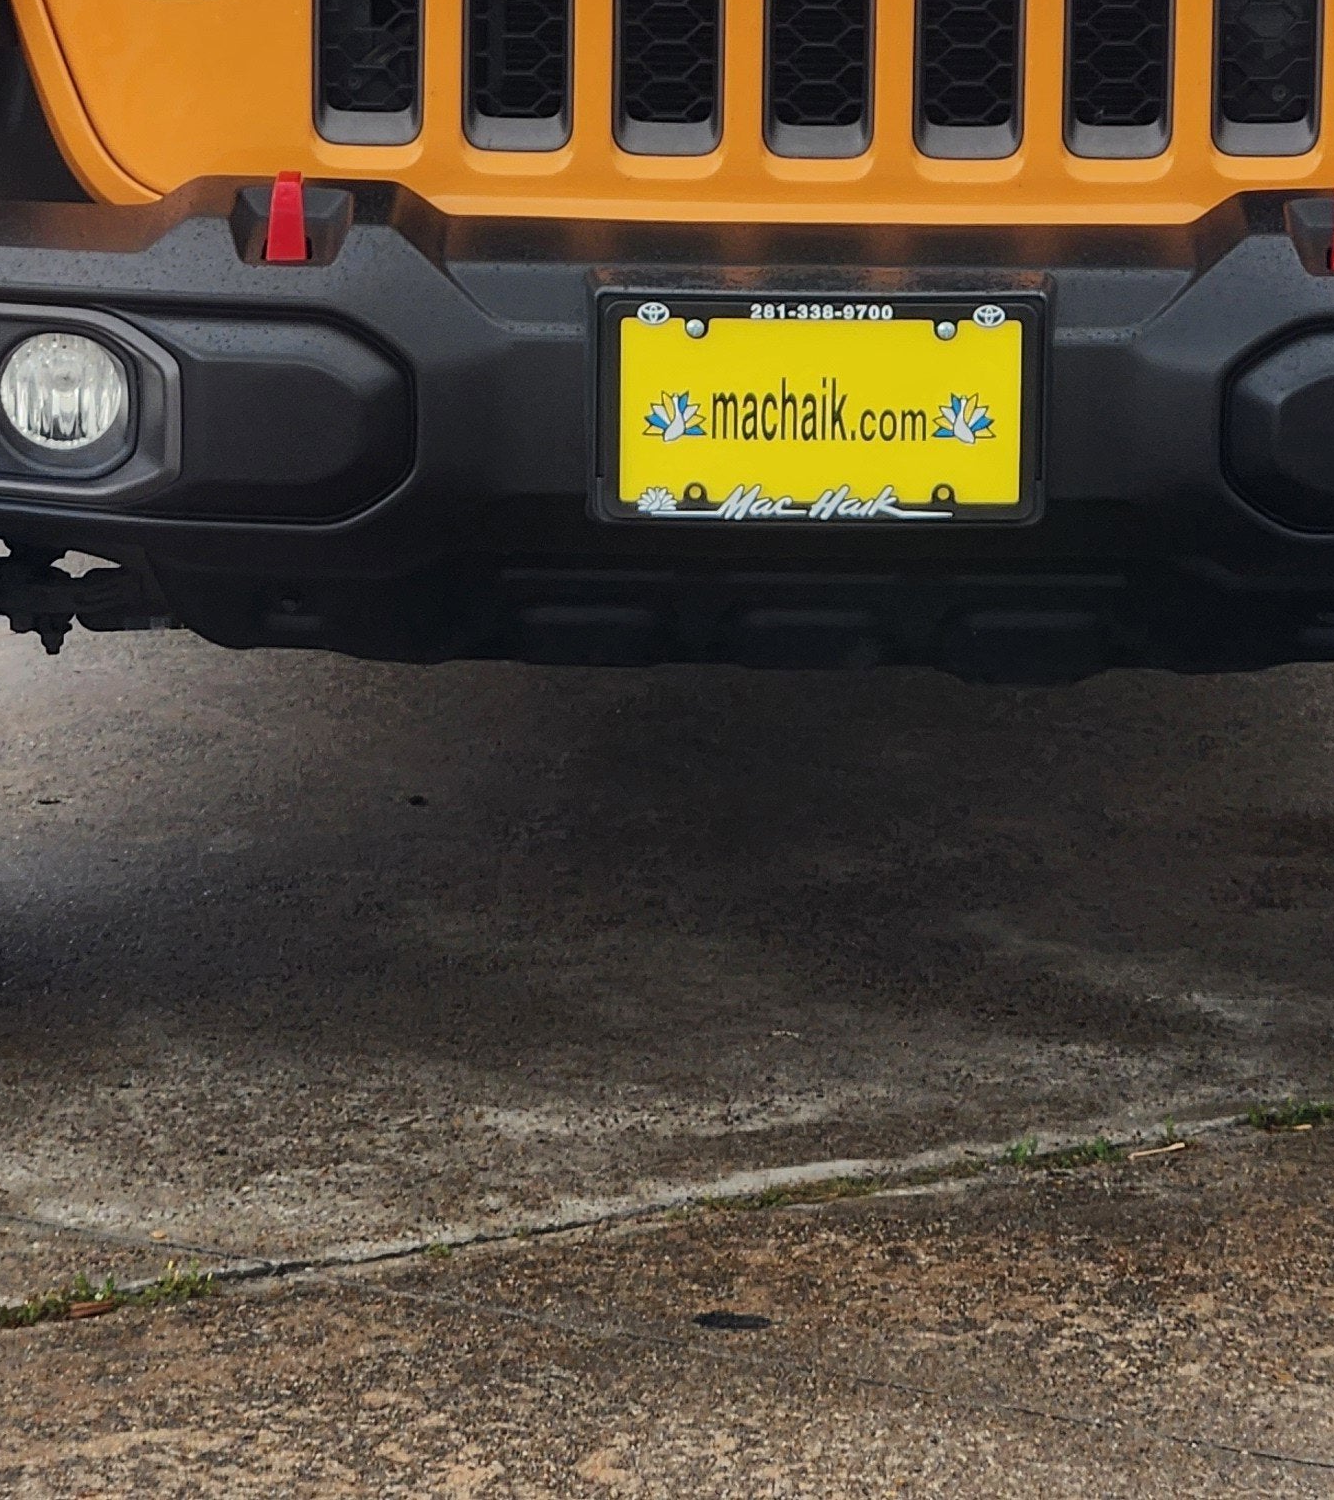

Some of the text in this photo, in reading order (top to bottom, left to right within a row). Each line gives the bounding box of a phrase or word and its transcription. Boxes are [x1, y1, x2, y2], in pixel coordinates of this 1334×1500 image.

[750, 303, 894, 321] 281-338-9700
[711, 377, 928, 442] machaik.com
[715, 484, 901, 521] Mac Haik
